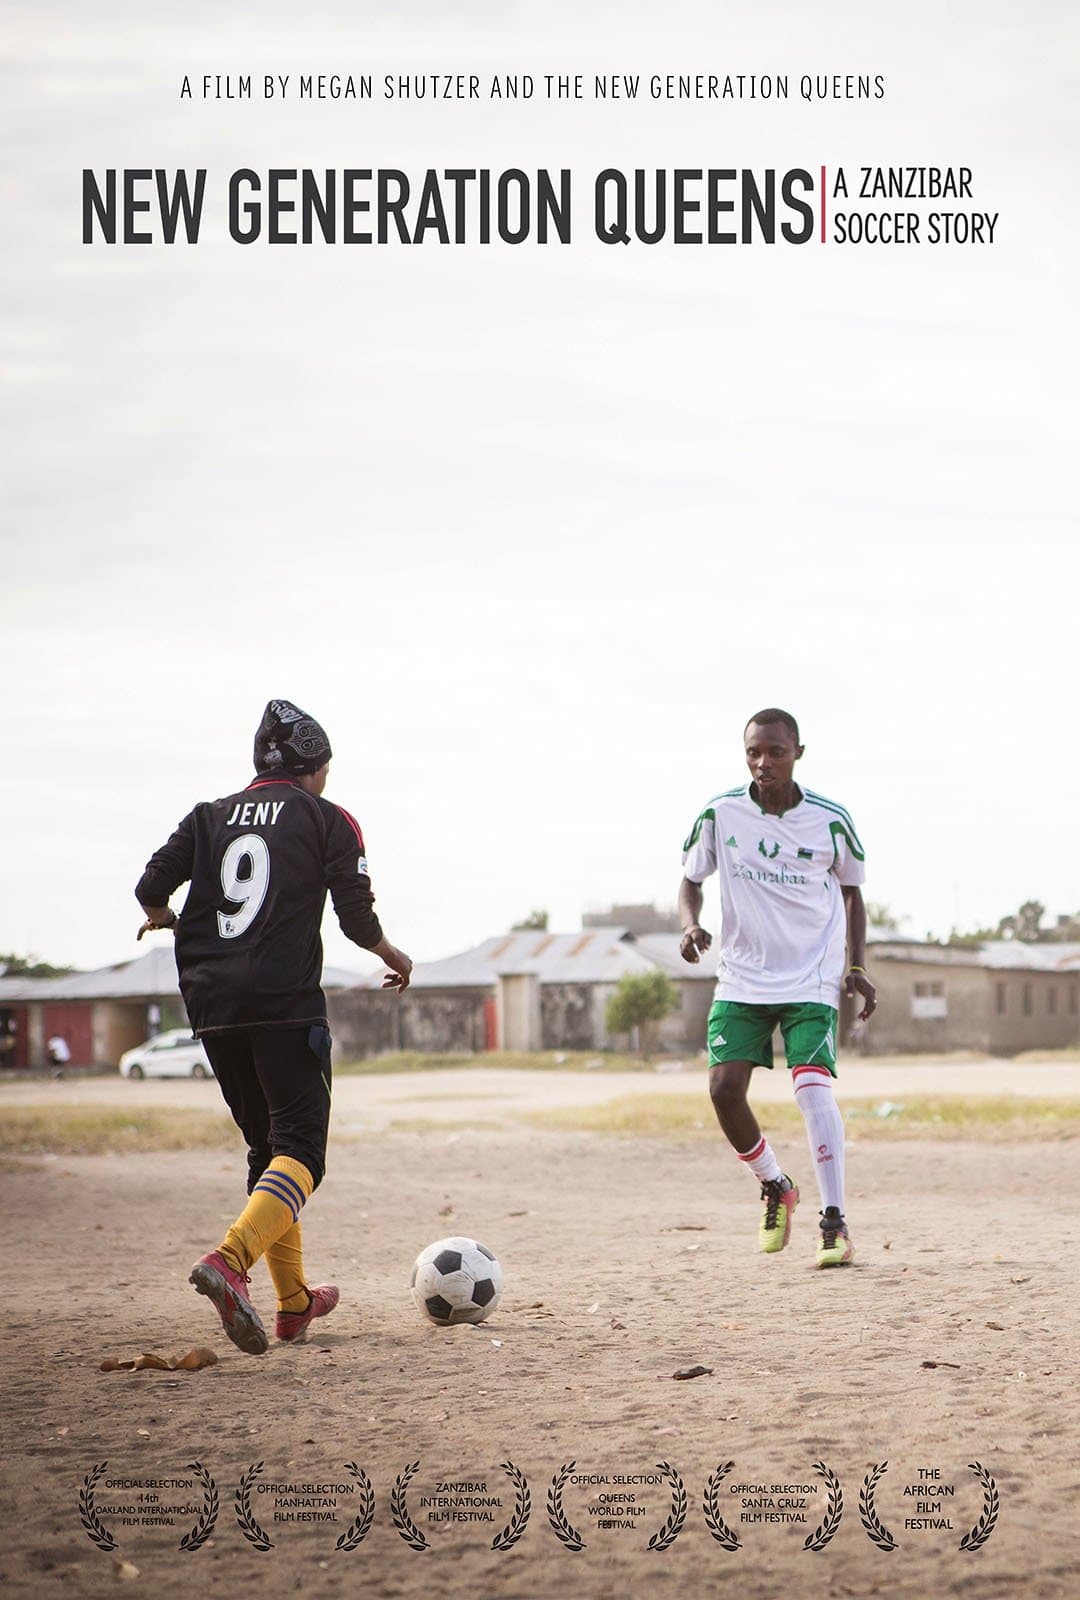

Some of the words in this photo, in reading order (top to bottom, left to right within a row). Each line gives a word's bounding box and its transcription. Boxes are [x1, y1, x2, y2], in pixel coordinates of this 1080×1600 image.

[227, 800, 286, 826] JENY
[216, 833, 271, 940] 9
[732, 862, 808, 885] Zanzibar
